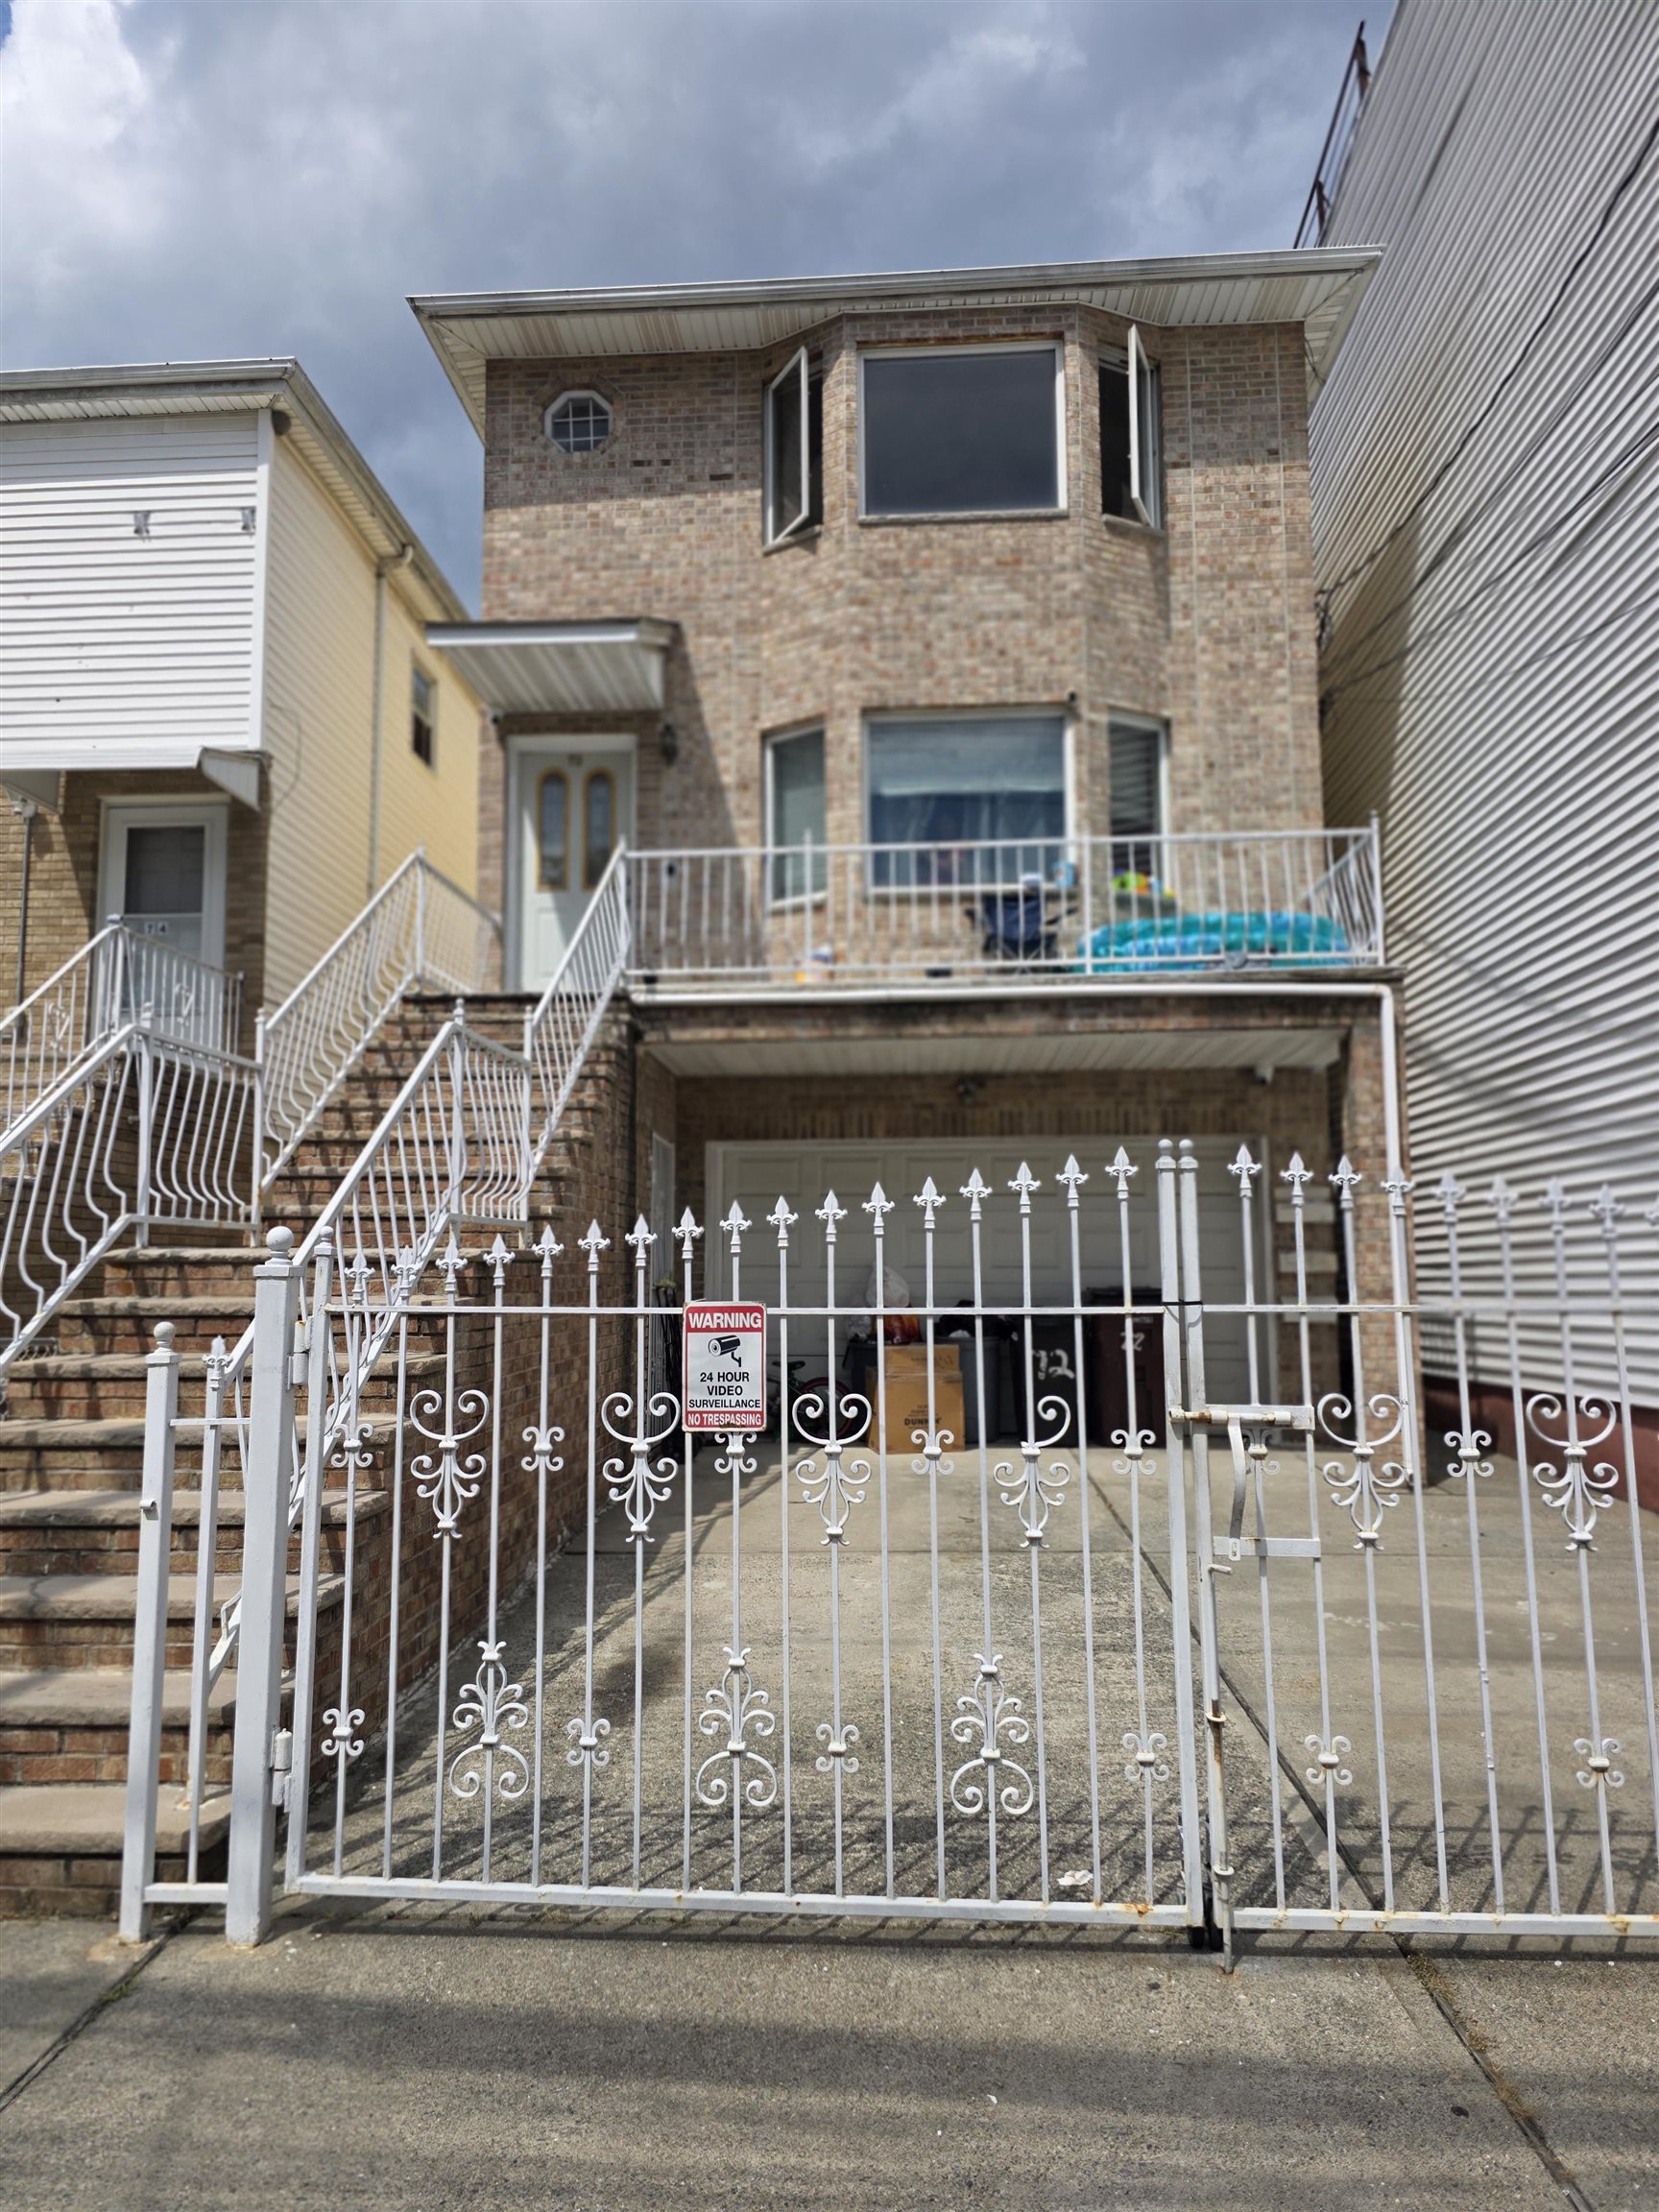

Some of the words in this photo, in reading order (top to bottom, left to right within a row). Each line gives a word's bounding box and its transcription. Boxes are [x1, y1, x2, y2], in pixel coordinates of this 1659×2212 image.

[688, 1312, 761, 1329] WARNING
[700, 1372, 713, 1382] 24
[717, 1372, 750, 1382] HOUR
[707, 1385, 743, 1396] VIDEO
[688, 1399, 761, 1408] SURVEILLANCE
[687, 1413, 701, 1426] NO
[702, 1413, 761, 1426] TRESPASSING
